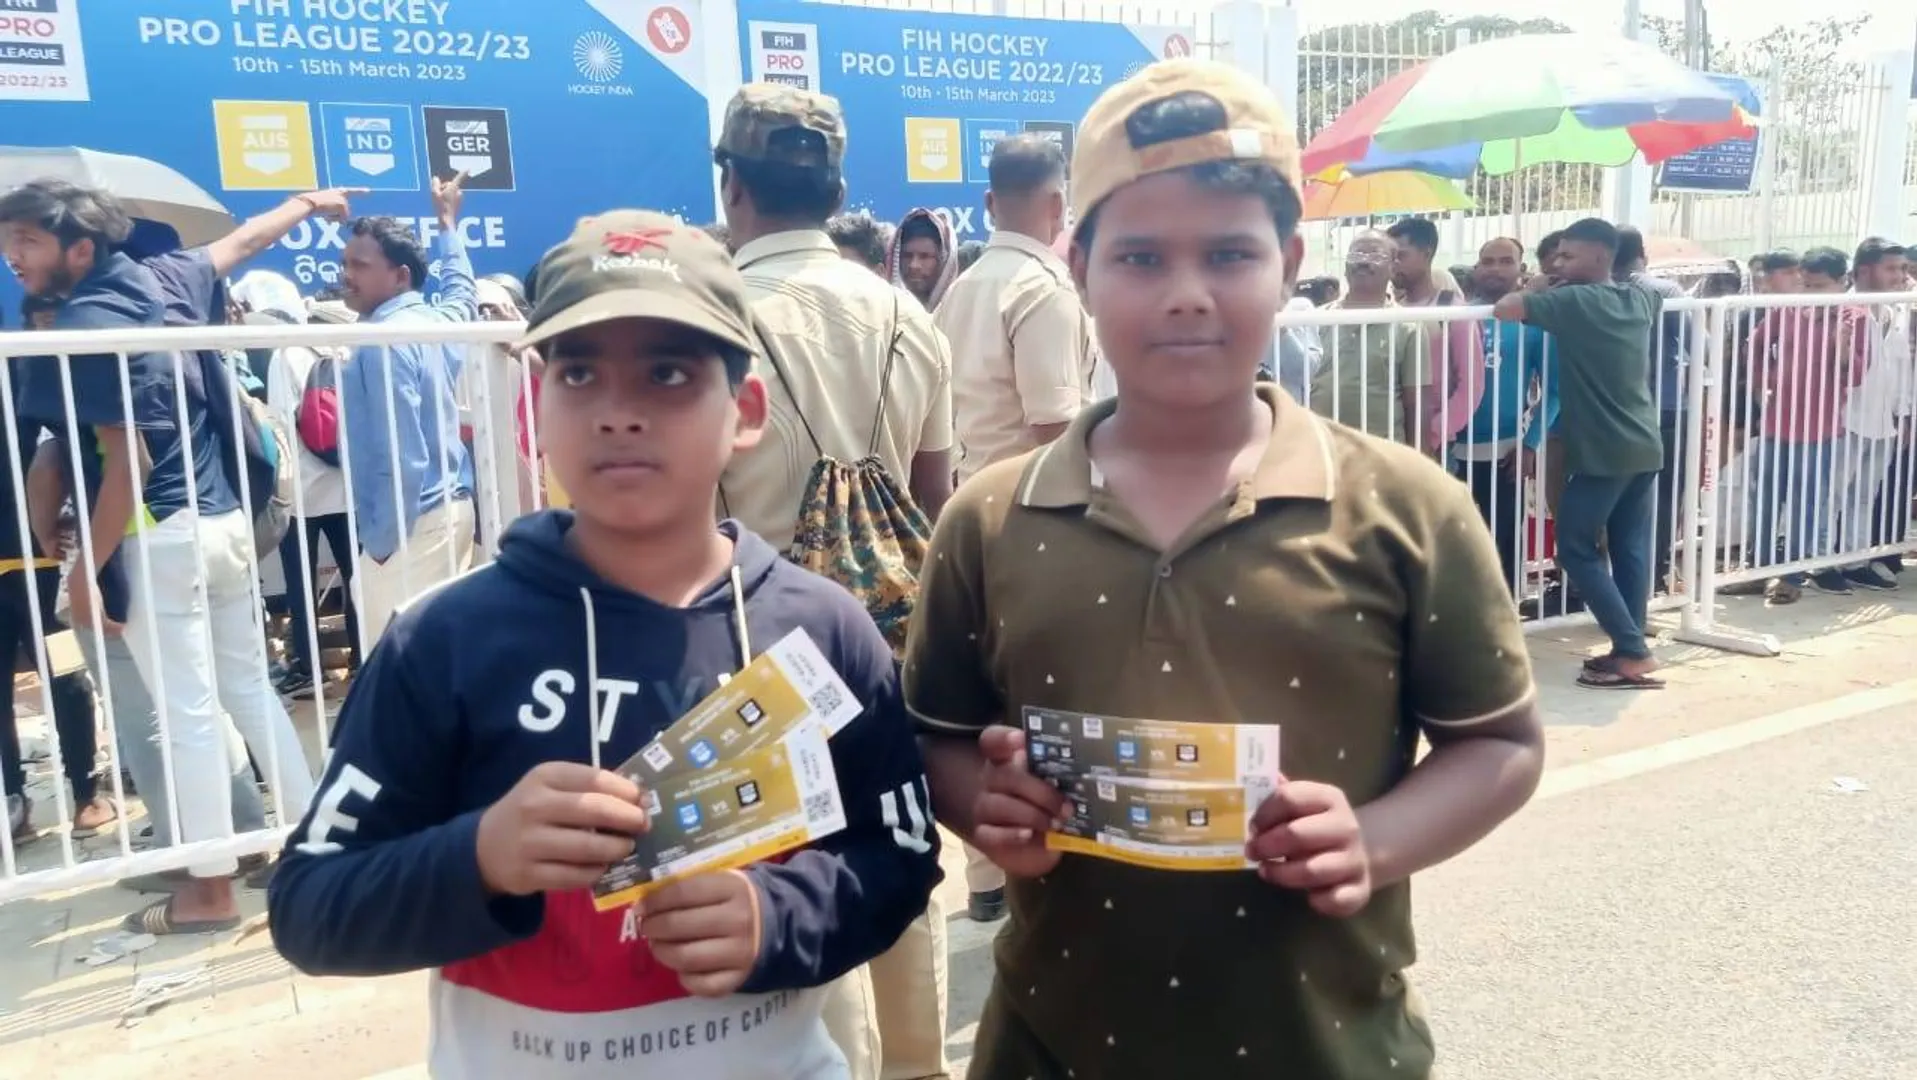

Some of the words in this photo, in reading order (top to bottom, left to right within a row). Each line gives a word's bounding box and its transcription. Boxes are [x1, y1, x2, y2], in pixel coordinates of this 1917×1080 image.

[231, 0, 290, 17] FIH
[304, 0, 448, 25] HOCKEY
[0, 17, 55, 37] PRO
[138, 17, 221, 45] PRO
[231, 22, 382, 53] LEAGUE
[393, 29, 531, 61] 2022/23
[902, 28, 942, 52] FIH
[950, 32, 1049, 57] HOCKEY
[0, 46, 61, 60] LEAGUE
[767, 54, 804, 70] PRO
[232, 56, 279, 74] 10th
[301, 58, 343, 77] 15th
[348, 60, 411, 79] March
[416, 62, 467, 81] 2023
[841, 52, 896, 77] PRO
[903, 56, 1001, 81] LEAGUE
[1008, 61, 1104, 87] 2022/23
[0, 74, 68, 88] 2022/23
[901, 85, 931, 100] 10th
[945, 86, 974, 101] 15th
[978, 87, 1019, 103] March
[1022, 89, 1056, 104] 2023
[243, 131, 290, 149] AUS
[346, 133, 393, 151] IND
[447, 135, 491, 153] GER
[513, 1030, 554, 1059] BACK
[565, 1041, 591, 1063] UP
[605, 1023, 696, 1062] CHOICE
[705, 1016, 730, 1043] OF
